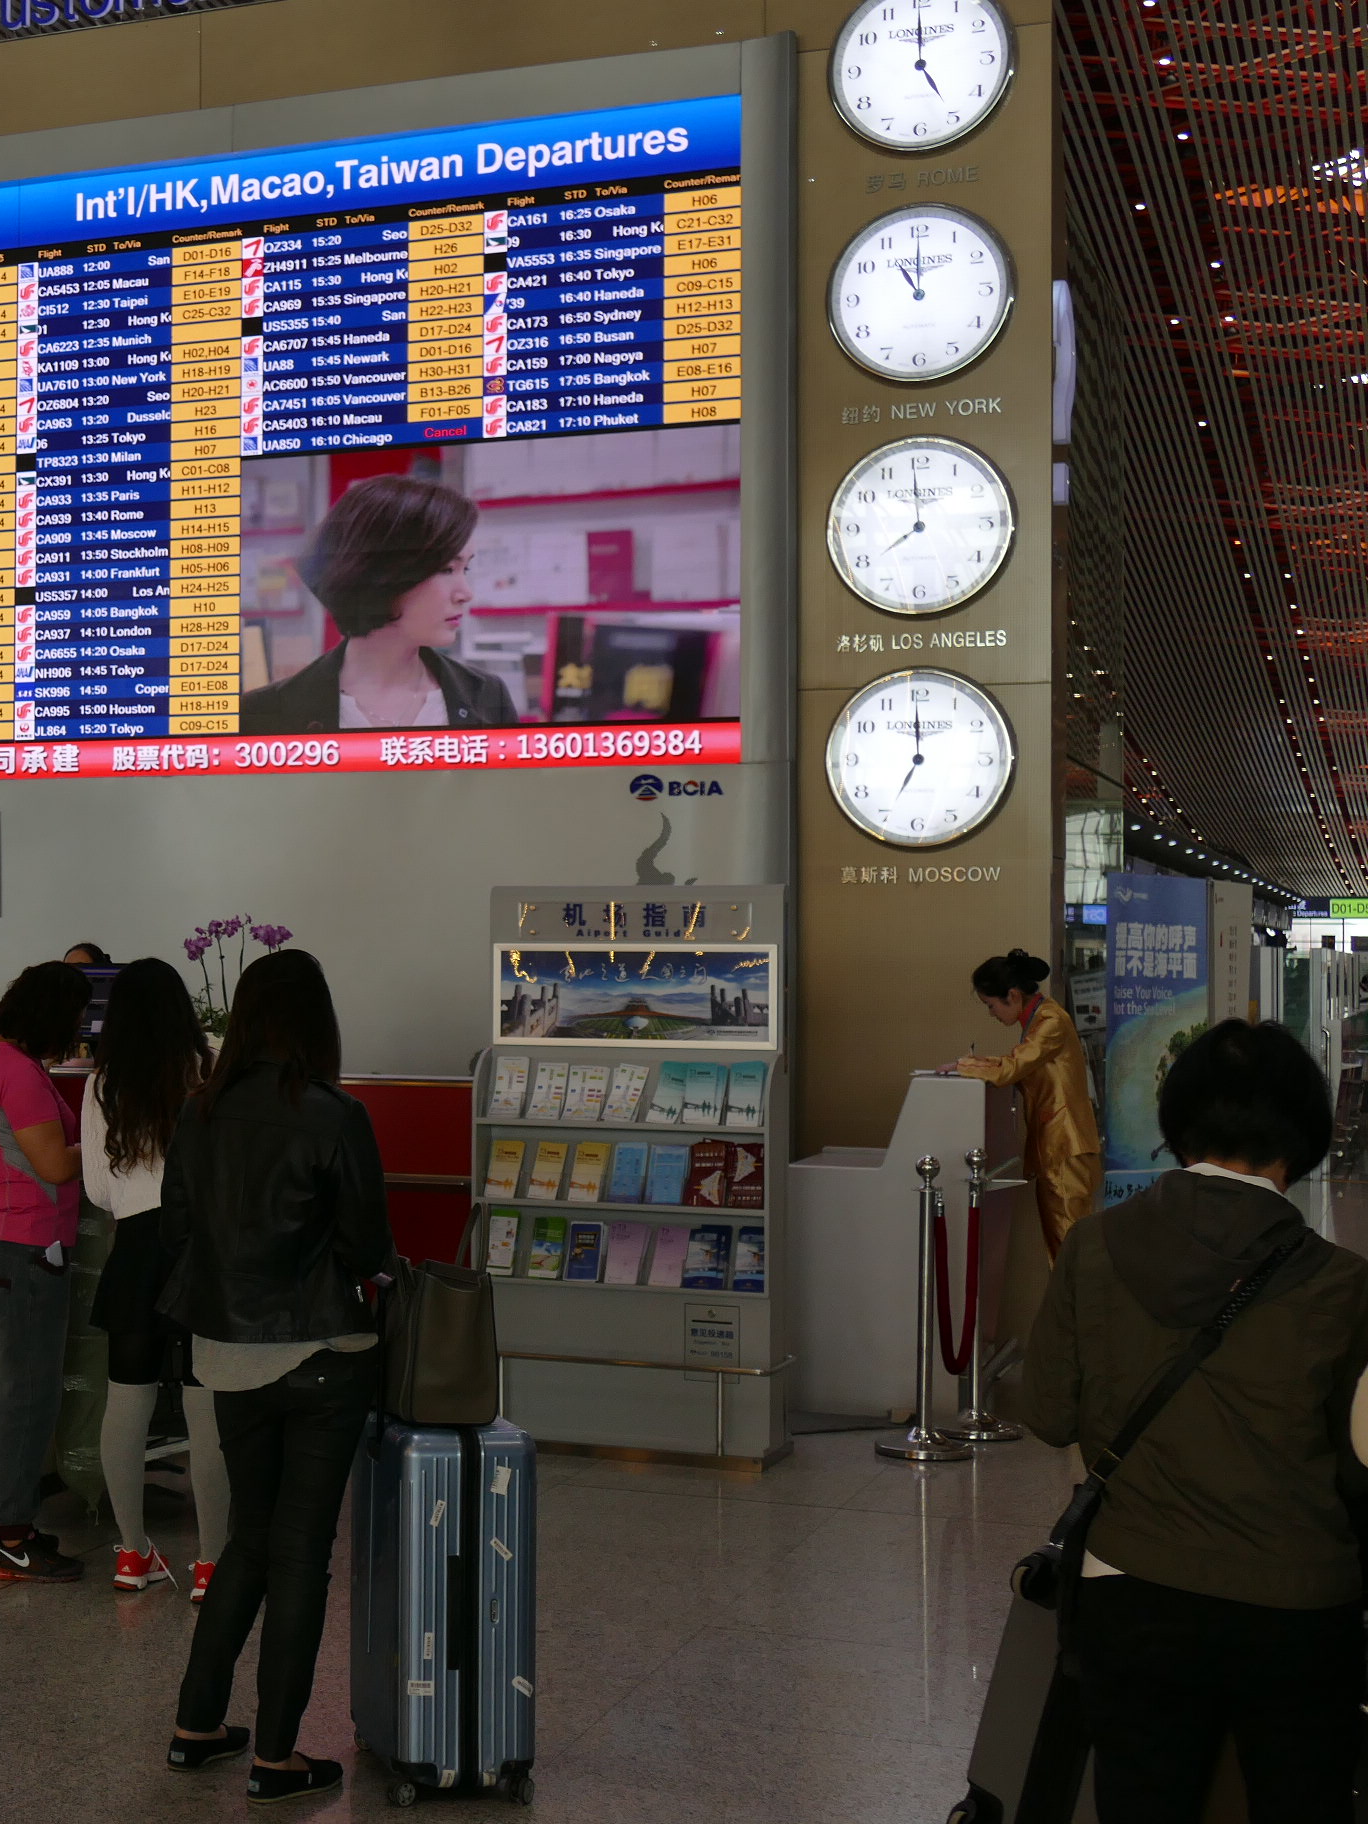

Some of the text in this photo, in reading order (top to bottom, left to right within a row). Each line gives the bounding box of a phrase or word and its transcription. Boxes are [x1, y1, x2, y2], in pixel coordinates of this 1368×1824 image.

[888, 24, 954, 40] LONGINES
[476, 125, 689, 176] Departures
[865, 167, 978, 193] 罗马 ROME
[508, 195, 717, 227] CA161 16:25 Osaka H06
[38, 229, 242, 259] Flight STD To/Via Counter/Remark
[507, 236, 732, 268] VA5553 16:35 Singapore E17-E31
[38, 247, 231, 278] UA888 12:00 San D01-D16
[508, 258, 717, 288] CA421 16:40 Tokyo H06
[887, 254, 952, 268] LONGINES
[38, 267, 230, 297] CA5453 12:05 Macau F14-F18
[507, 299, 733, 330] CA173 16:50 Sydney H12-H13
[508, 320, 733, 349] OZ316 16:50 Busan D25-D32
[508, 344, 717, 371] CA159 17:00 Nagoya H07
[508, 364, 732, 390] TG615 17:05 Bangkok E08-E16
[507, 407, 717, 433] CA821 17:10 Phuket H08
[842, 398, 1002, 425] 纽约 NEW YORK
[263, 426, 467, 450] UA850 16:10 Chicago Cancel
[37, 445, 216, 468] TP8323 13:30 Milan H07
[887, 487, 953, 499] LONGINES
[36, 522, 229, 544] CA909 13:45 Moscow H14-H15
[836, 630, 1007, 652] 洛杉矶 LOS ANGELES
[35, 720, 228, 736] JL864 15:20 Tokyo C09-C15
[886, 720, 953, 730] LONGINES
[668, 781, 724, 798] BCIA
[841, 865, 1000, 884] 莫斯科 MOSCOW
[563, 903, 706, 928] 机场指南
[643, 930, 690, 939] Guid
